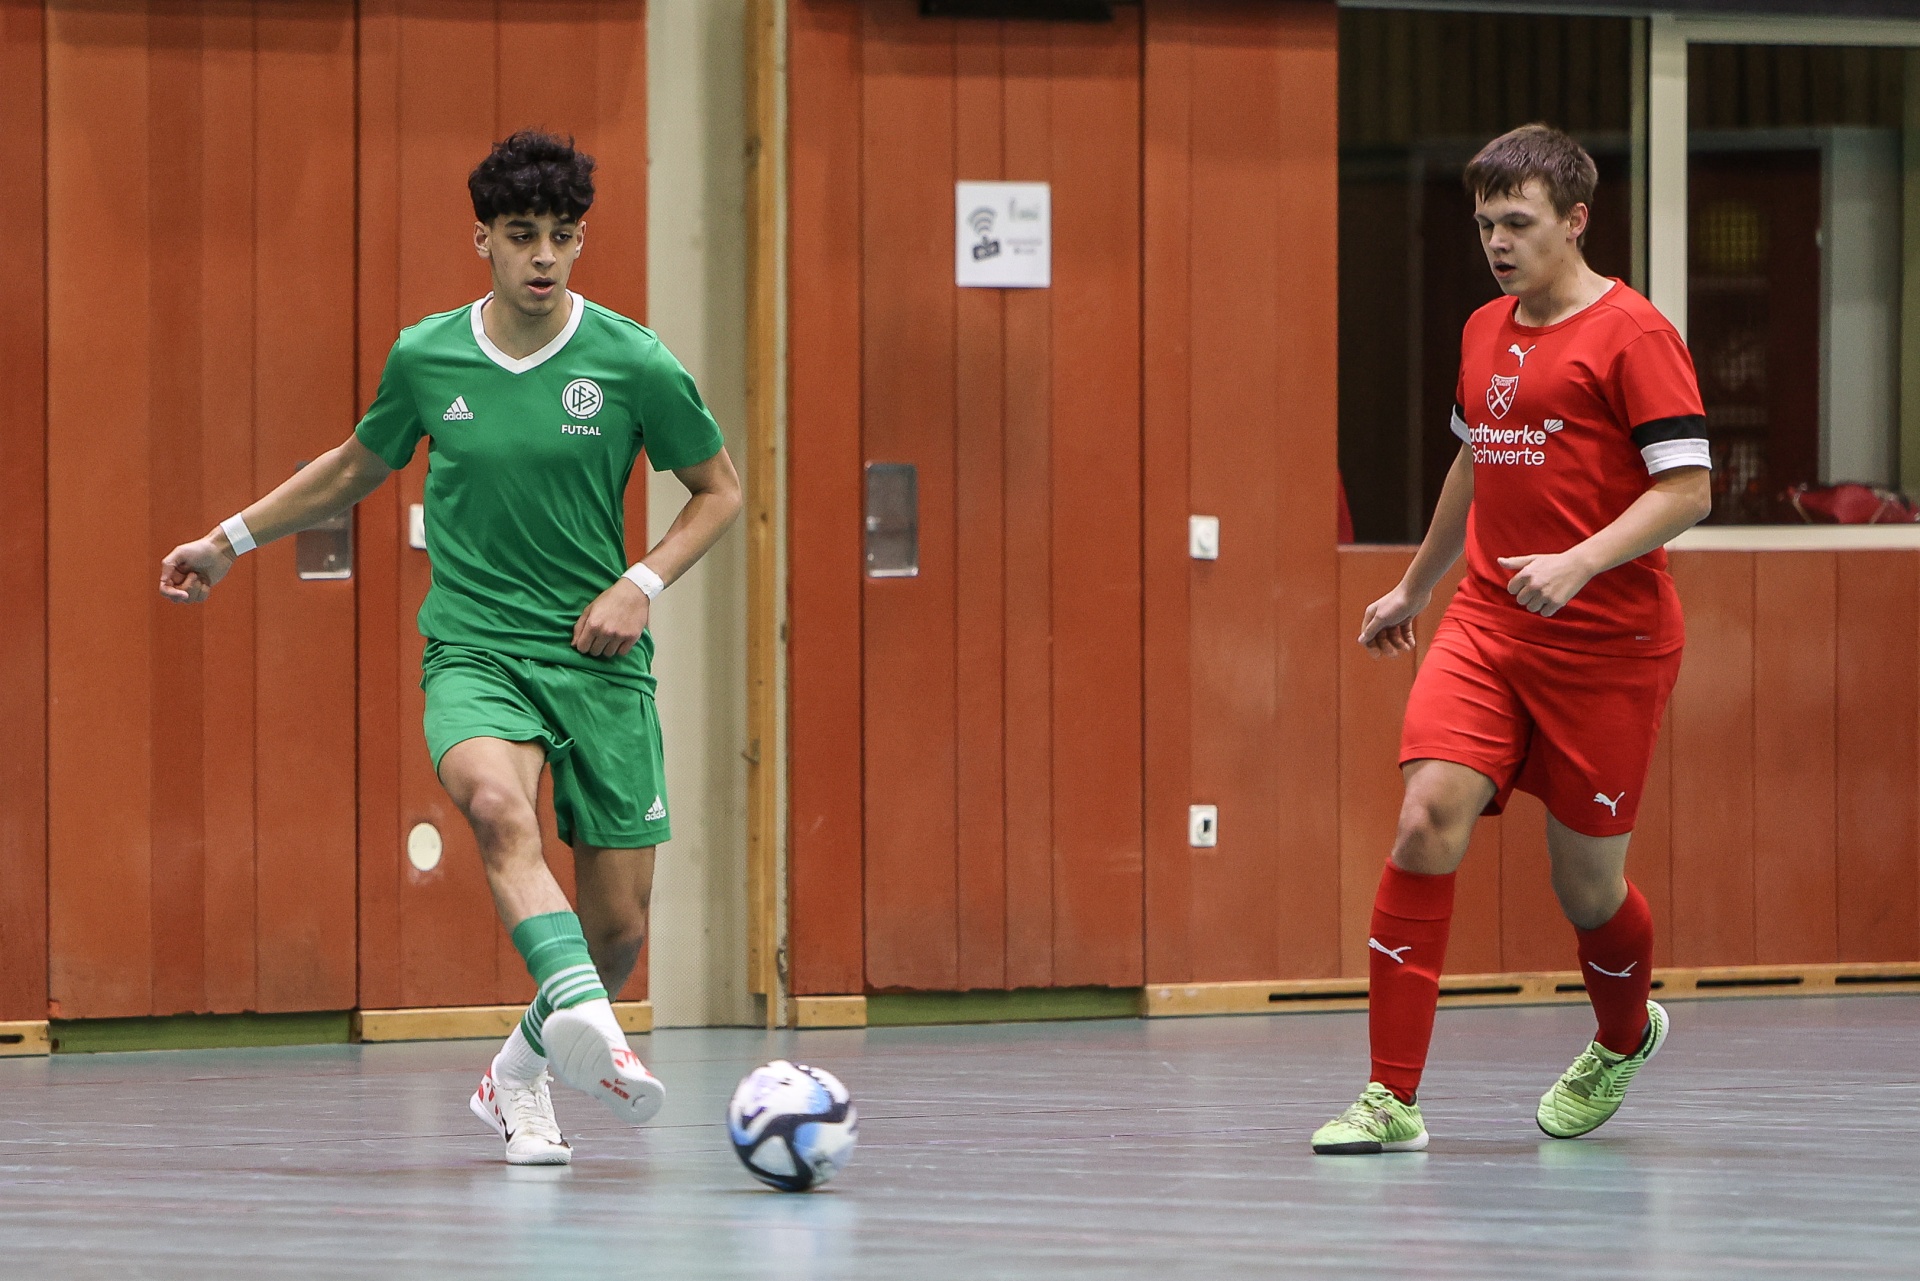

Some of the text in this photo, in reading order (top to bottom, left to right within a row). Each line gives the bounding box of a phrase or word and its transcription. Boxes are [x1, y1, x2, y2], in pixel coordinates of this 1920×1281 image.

[443, 412, 474, 421] adidas
[562, 424, 601, 436] FUTSAL
[1469, 423, 1547, 445] adtwerke
